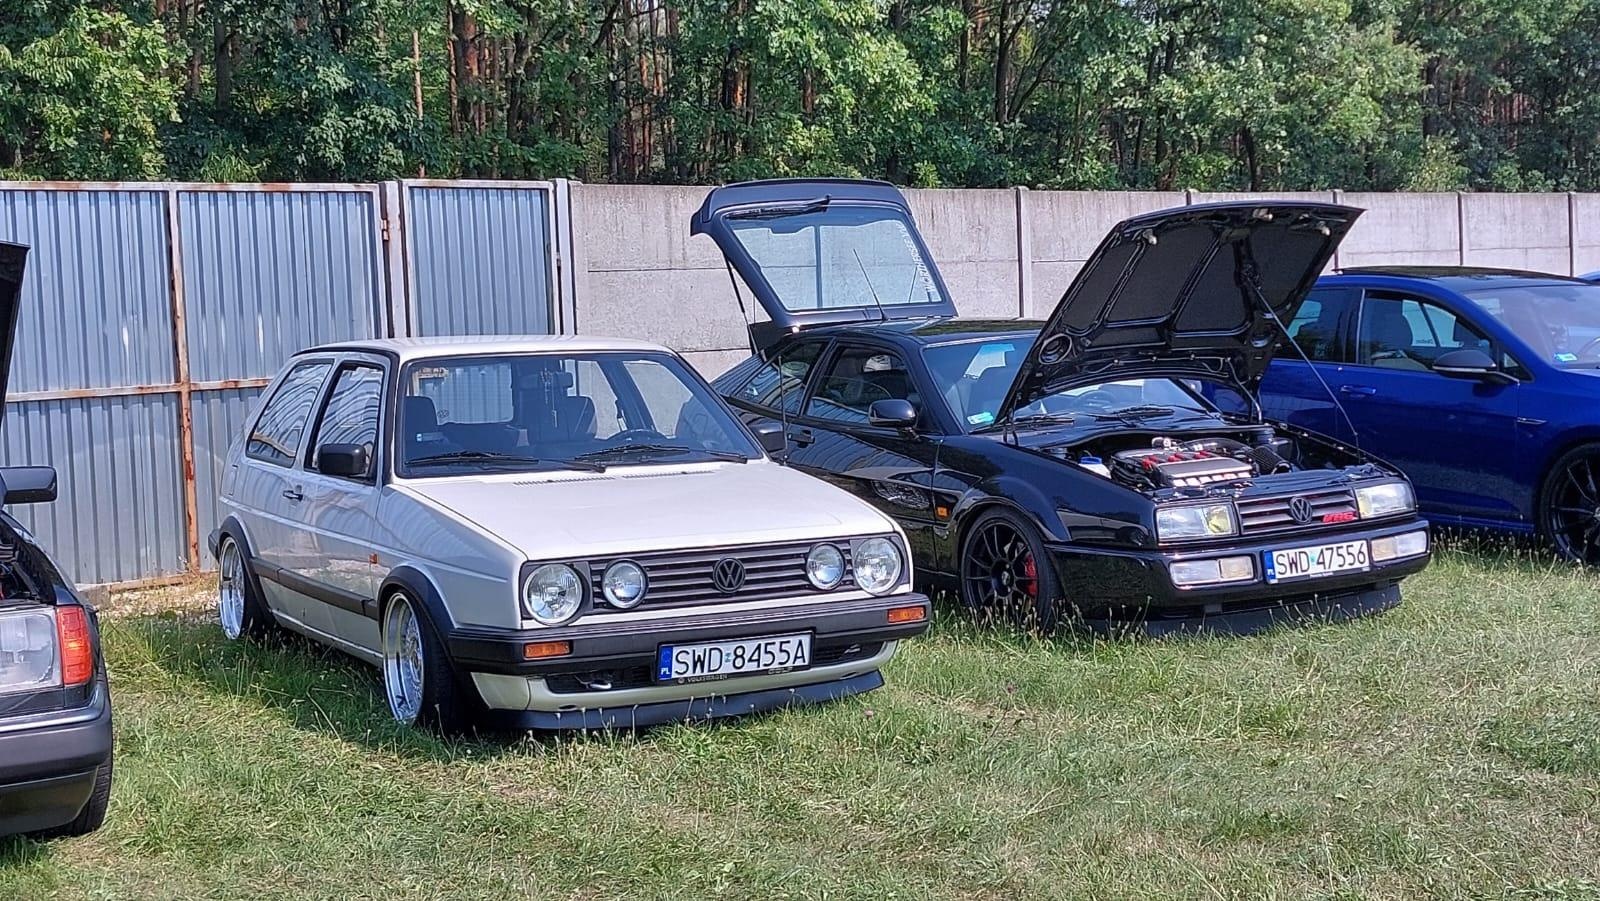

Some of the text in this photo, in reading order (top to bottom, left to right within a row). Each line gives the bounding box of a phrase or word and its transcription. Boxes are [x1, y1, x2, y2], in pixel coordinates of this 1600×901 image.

[1275, 543, 1366, 576] SWD 47556
[674, 639, 807, 676] SWD 8455A
[660, 667, 671, 676] PL
[687, 674, 728, 684] VOLKSWAGEN
